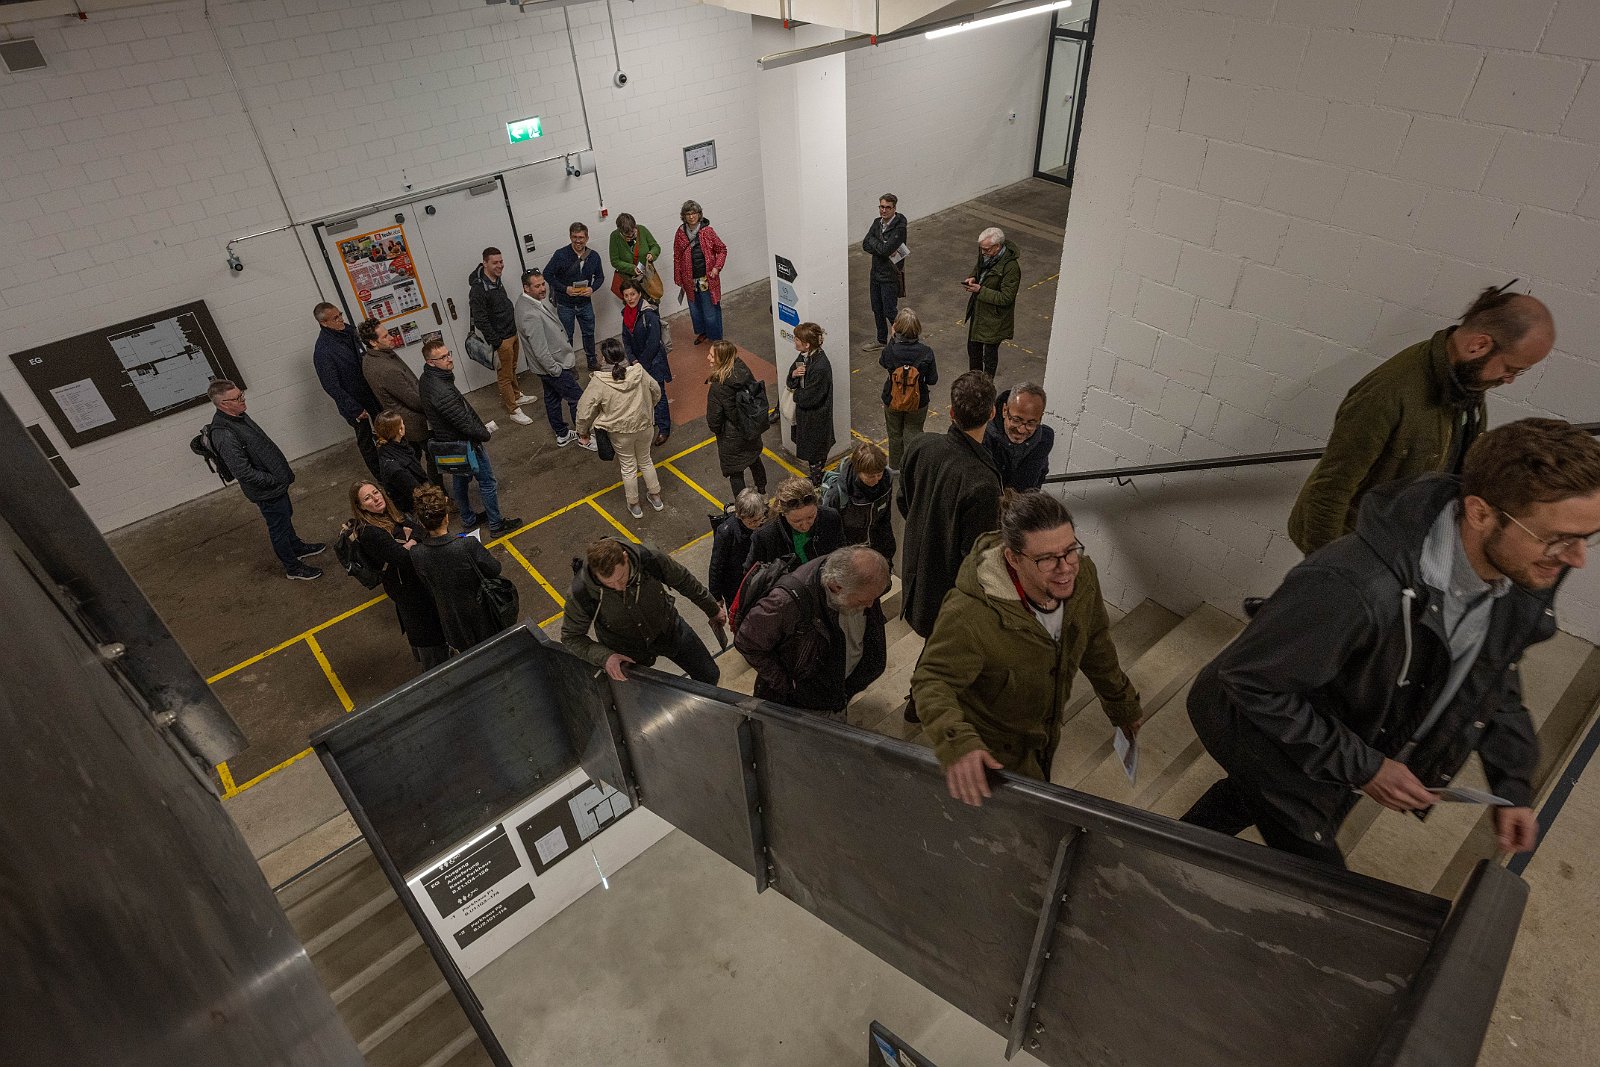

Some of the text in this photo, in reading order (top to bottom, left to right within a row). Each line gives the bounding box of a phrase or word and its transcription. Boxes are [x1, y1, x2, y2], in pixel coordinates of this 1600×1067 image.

[28, 357, 44, 366] EG
[444, 862, 469, 880] Ausgang
[447, 861, 480, 885] Anlieferung
[449, 860, 492, 890] Kasse Parkhaus
[462, 894, 487, 912] Parkhaus
[470, 909, 495, 928] Parkhaus
